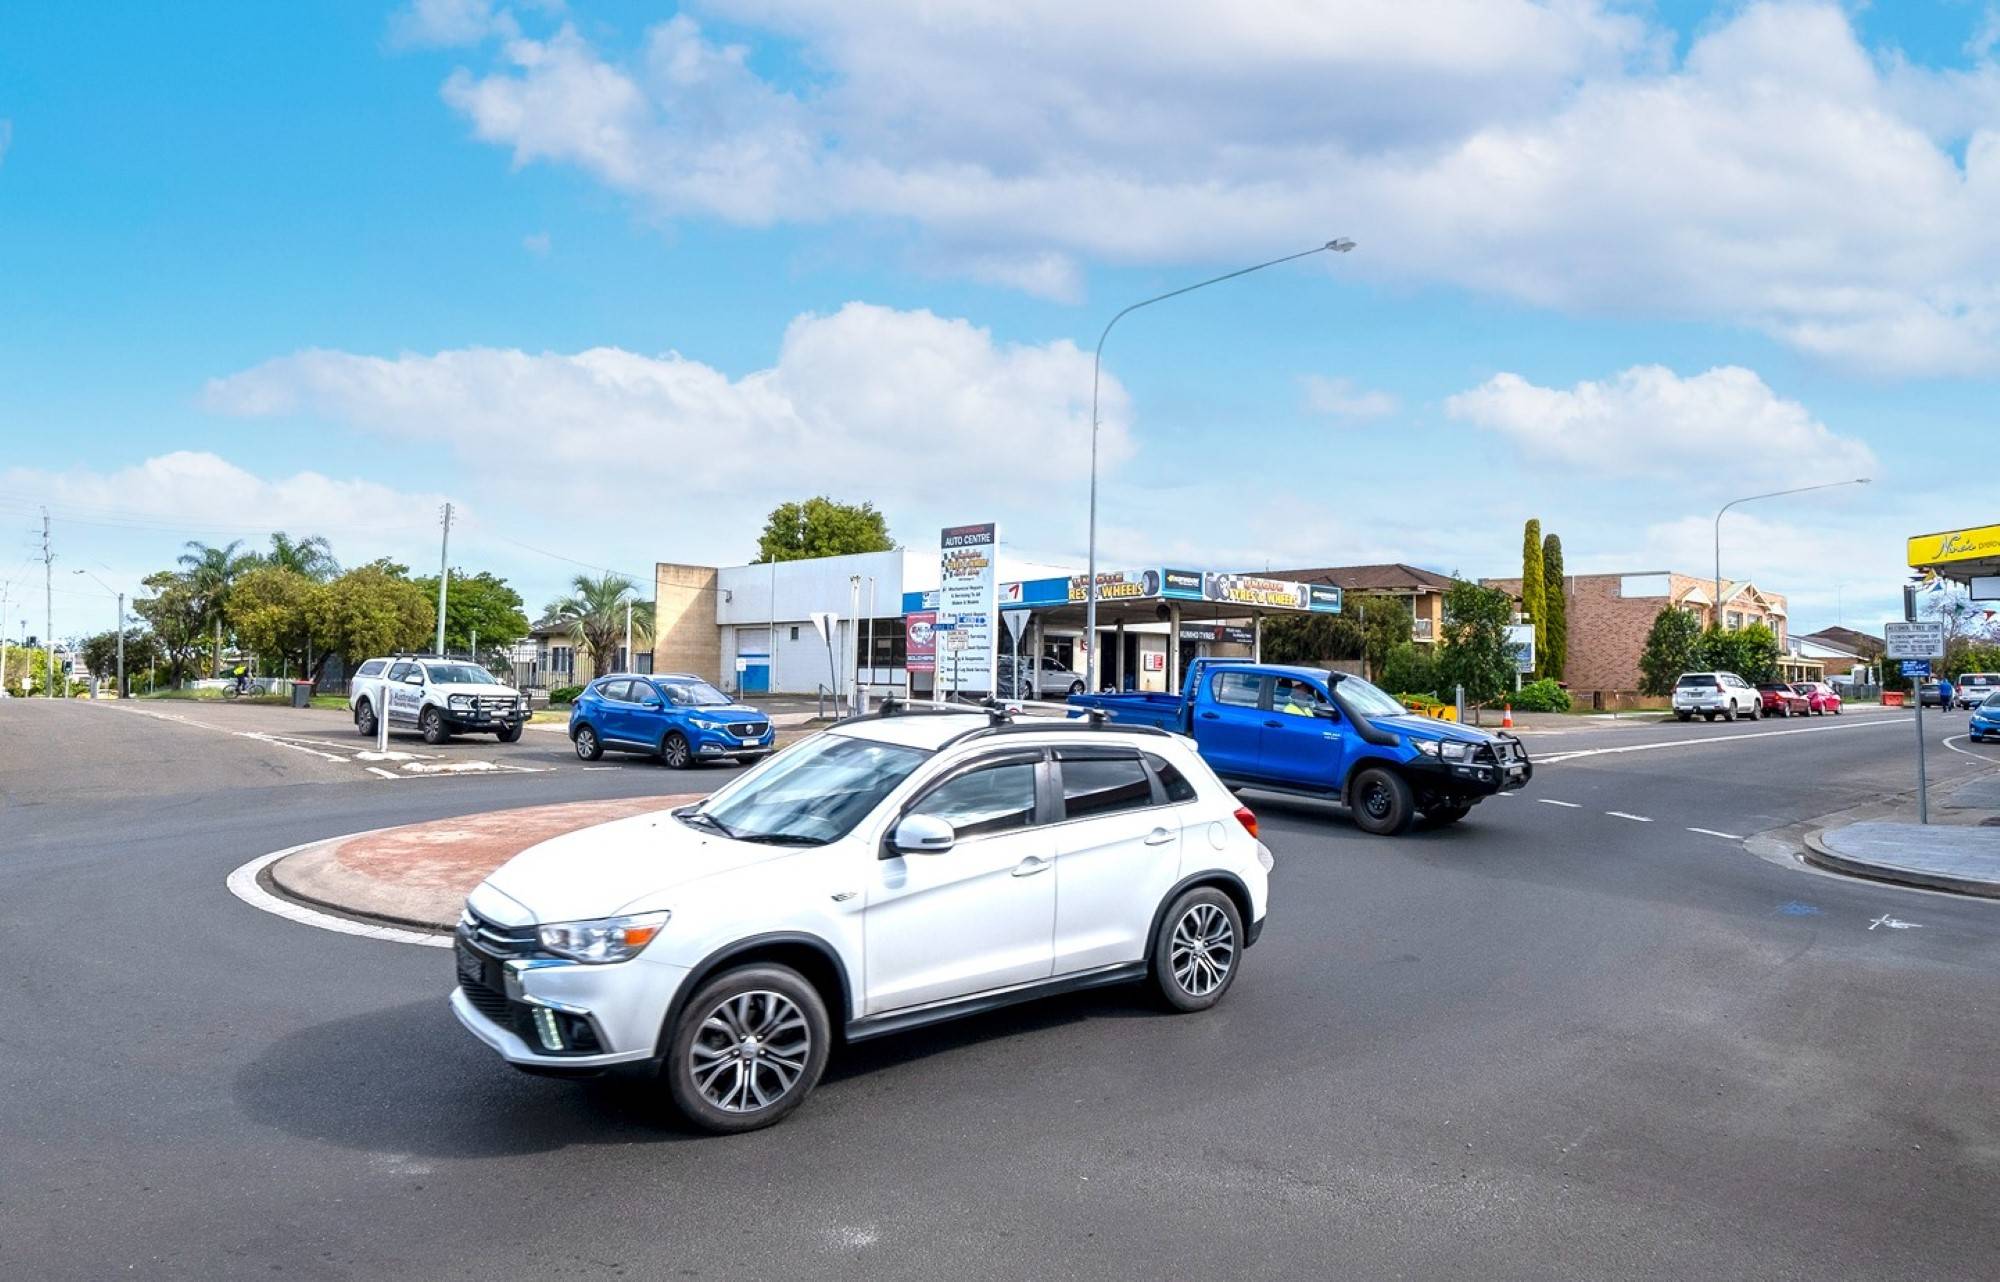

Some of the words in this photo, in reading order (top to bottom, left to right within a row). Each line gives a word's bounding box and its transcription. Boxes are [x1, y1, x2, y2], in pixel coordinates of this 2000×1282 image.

[945, 536, 963, 546] AUTO
[964, 533, 991, 544] CENTRE
[1072, 573, 1123, 587] UNQUE
[1069, 587, 1087, 600] RES
[1101, 583, 1144, 597] WHEELS
